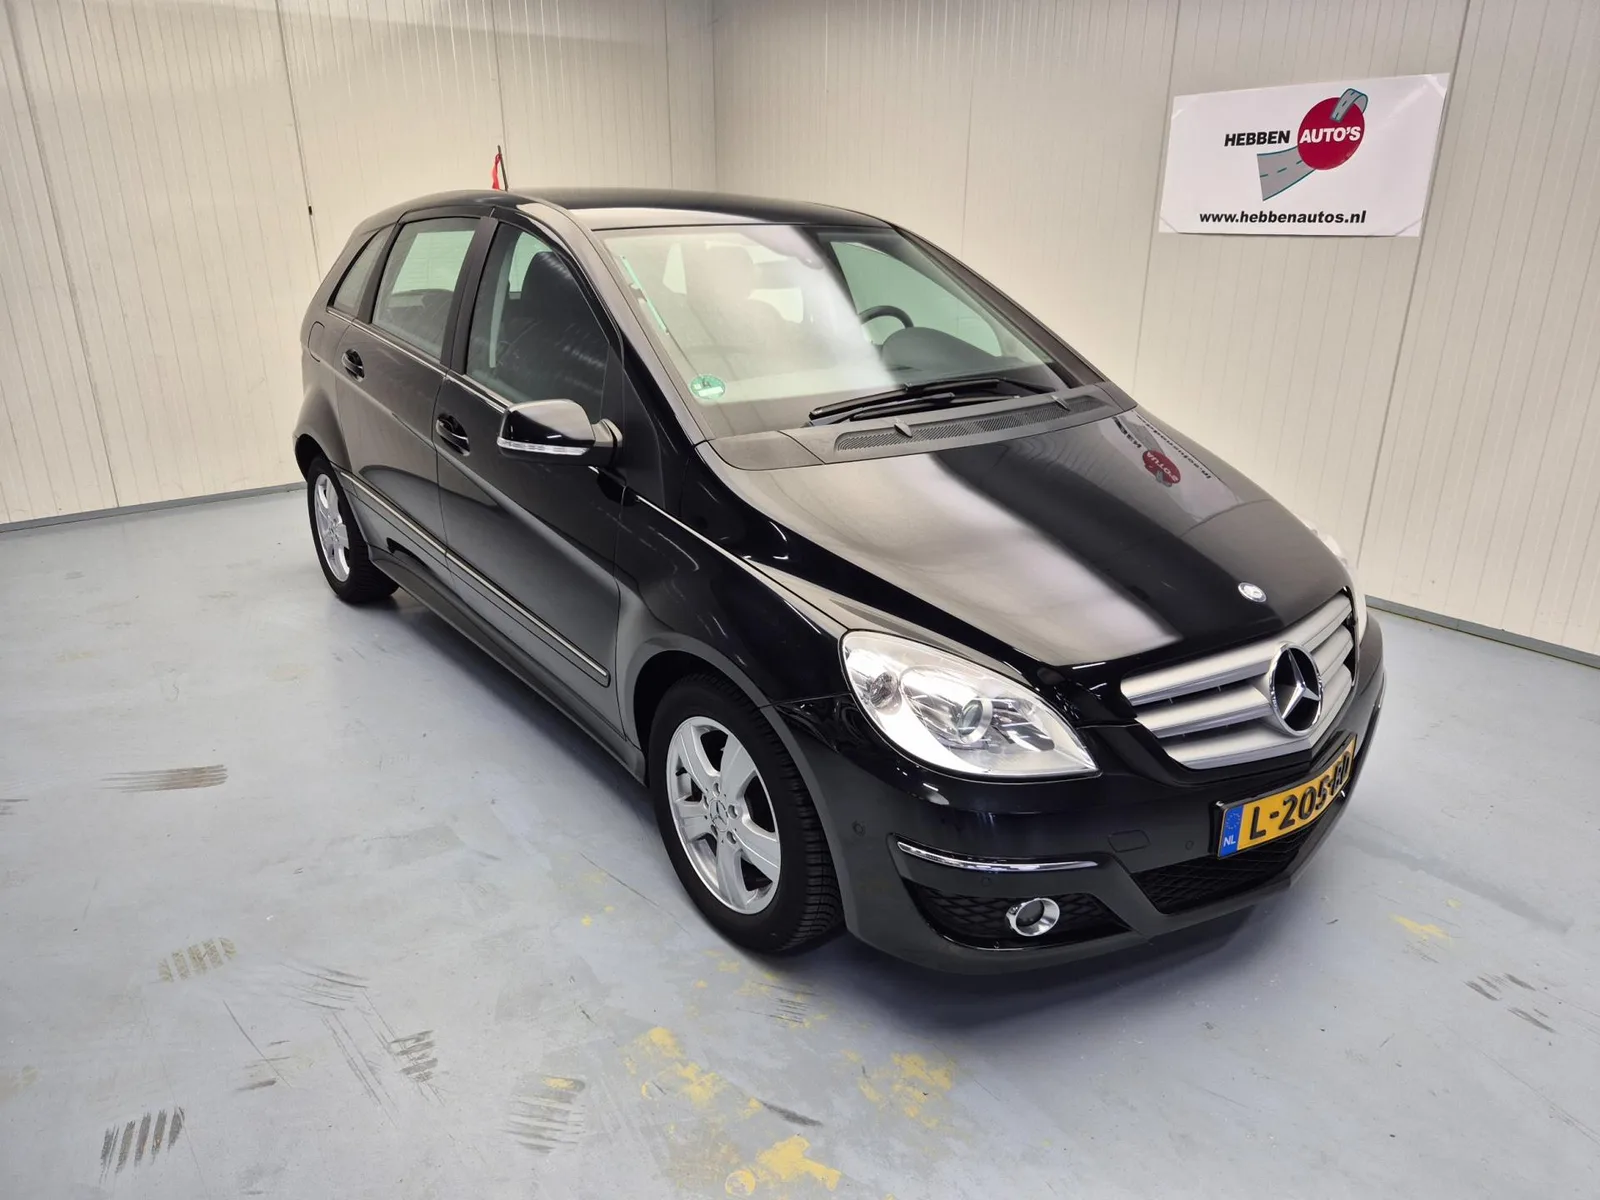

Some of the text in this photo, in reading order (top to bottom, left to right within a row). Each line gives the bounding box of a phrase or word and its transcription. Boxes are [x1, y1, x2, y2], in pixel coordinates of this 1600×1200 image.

[1224, 126, 1362, 147] HEBBEN AUTO'S
[1199, 210, 1366, 224] www.hebbenautos.nl
[1223, 834, 1236, 847] NL
